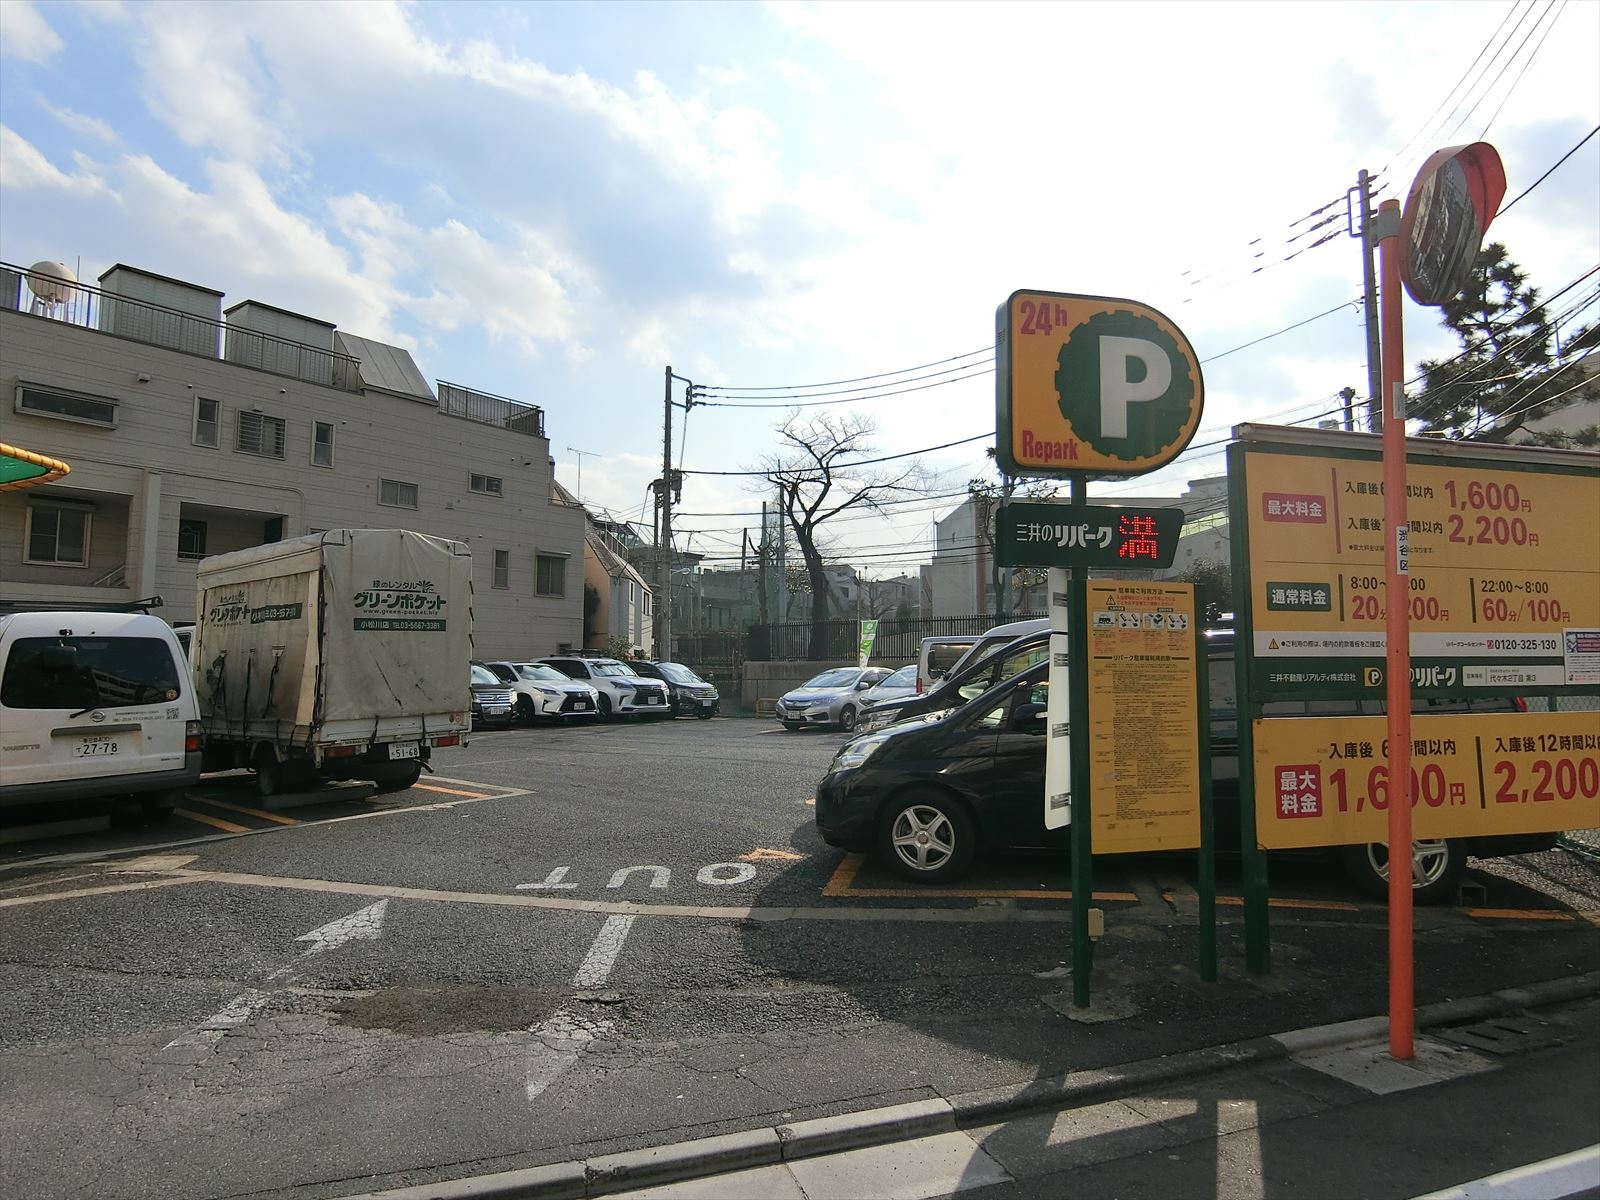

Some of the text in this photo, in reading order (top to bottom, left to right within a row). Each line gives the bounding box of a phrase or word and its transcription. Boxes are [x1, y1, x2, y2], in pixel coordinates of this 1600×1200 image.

[1020, 300, 1067, 336] 24h
[1099, 335, 1172, 439] P
[1022, 430, 1078, 463] Repark
[1444, 480, 1531, 512] 1,600円
[1268, 500, 1322, 517] 最大料金
[1016, 523, 1113, 549] 三井のリパーク
[1119, 515, 1159, 559] 満
[1447, 514, 1539, 546] 2,200円
[373, 580, 418, 590] 緑のレンタル
[354, 592, 447, 610] グリーンポケット
[1272, 589, 1327, 605] 通常料金
[361, 621, 389, 629] 小松川店
[1494, 639, 1557, 650] 0120-325-130
[1269, 673, 1357, 683] 三井不動産リアルティ株式会社
[1490, 675, 1524, 683] 代々木2丁目
[83, 742, 118, 755] 27-78
[396, 747, 418, 758] 51-68
[1281, 770, 1316, 791] 最大
[1494, 757, 1599, 804] 2,200
[1281, 794, 1318, 814] 料金
[515, 862, 757, 889] OUT
